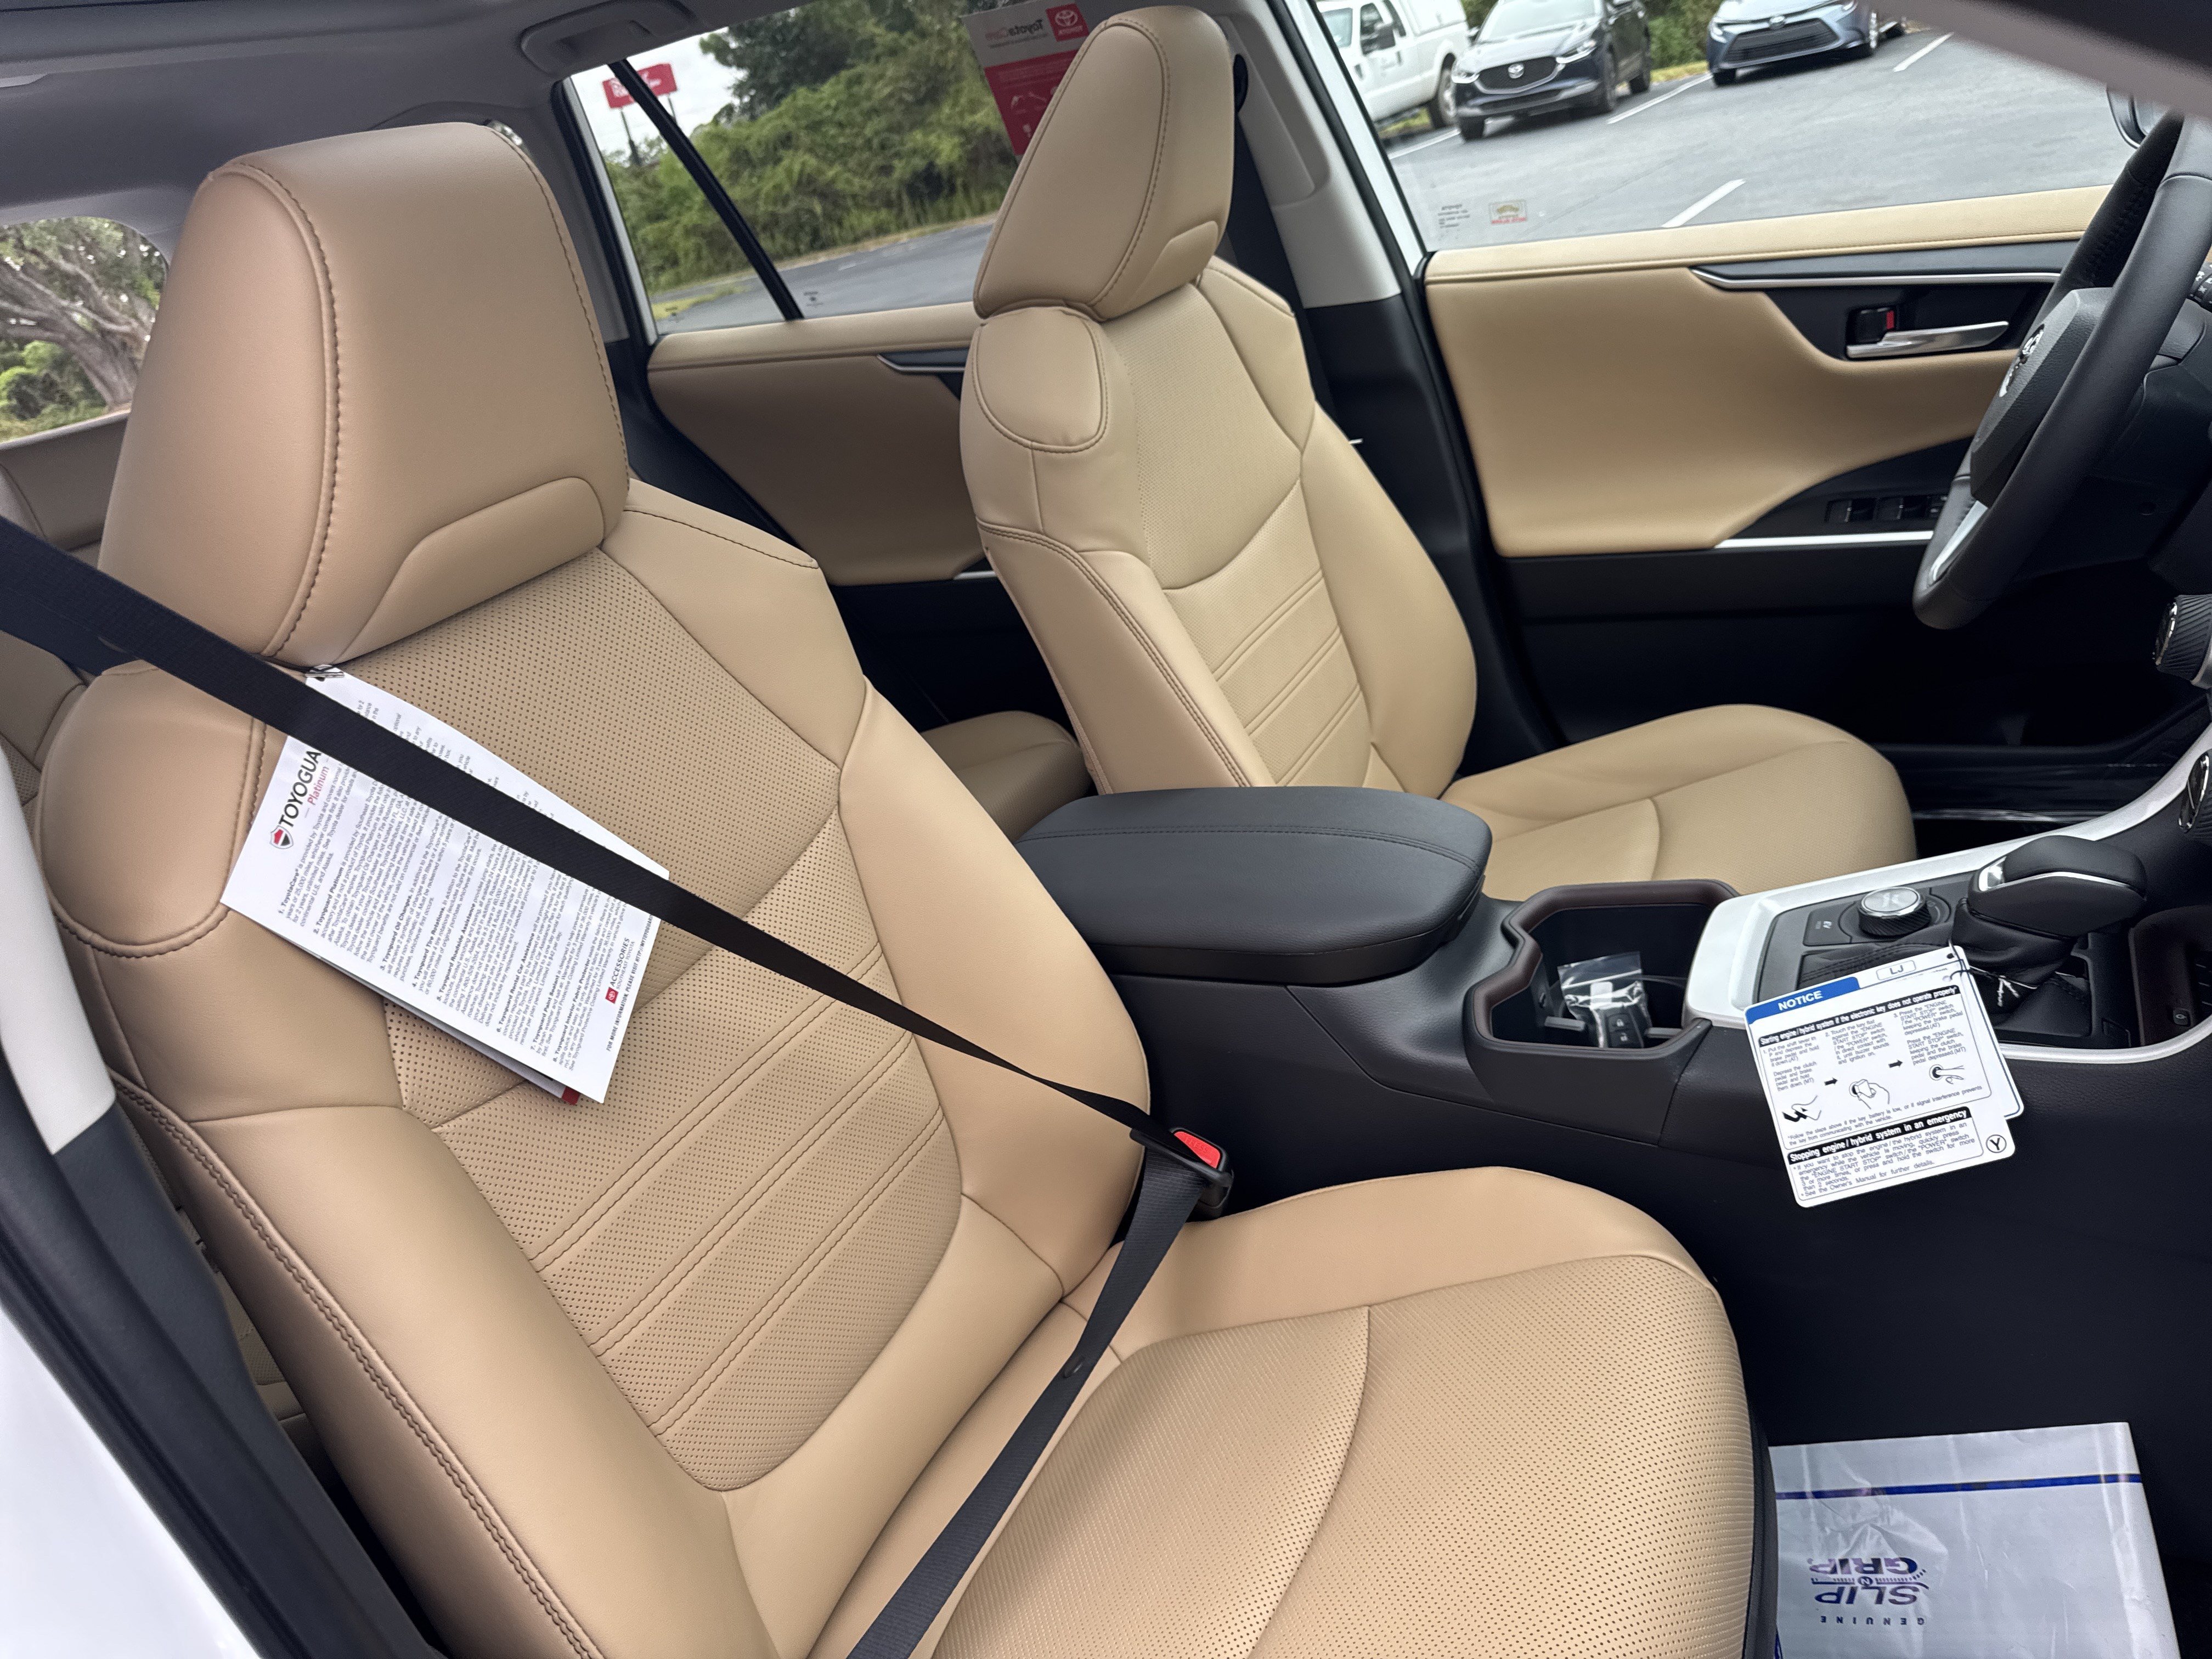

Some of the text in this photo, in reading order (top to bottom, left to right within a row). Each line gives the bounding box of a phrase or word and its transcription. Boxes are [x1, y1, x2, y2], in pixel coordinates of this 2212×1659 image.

[278, 750, 321, 830] TOYOGUA
[306, 763, 330, 806] Platinum
[610, 936, 629, 988] ACCESSORIES
[616, 940, 635, 990] SOUTHEAST TOYOTA
[1890, 964, 1904, 975] LJ
[609, 1025, 618, 1041] MORE
[614, 991, 629, 1026] INFORMATION,
[625, 974, 634, 992] PLEASE
[1778, 991, 1823, 1011] NOTICE
[1790, 1147, 1821, 1164] Stopping
[1821, 1140, 1847, 1156] engine
[1849, 1133, 1874, 1148] hybrid
[1875, 1126, 1902, 1142] system
[1903, 1122, 1912, 1134] in
[1914, 1121, 1925, 1131] an
[1926, 1109, 1967, 1128] emergency
[1815, 1586, 1920, 1605] SLIP
[1820, 1616, 1925, 1625] GENUINE
